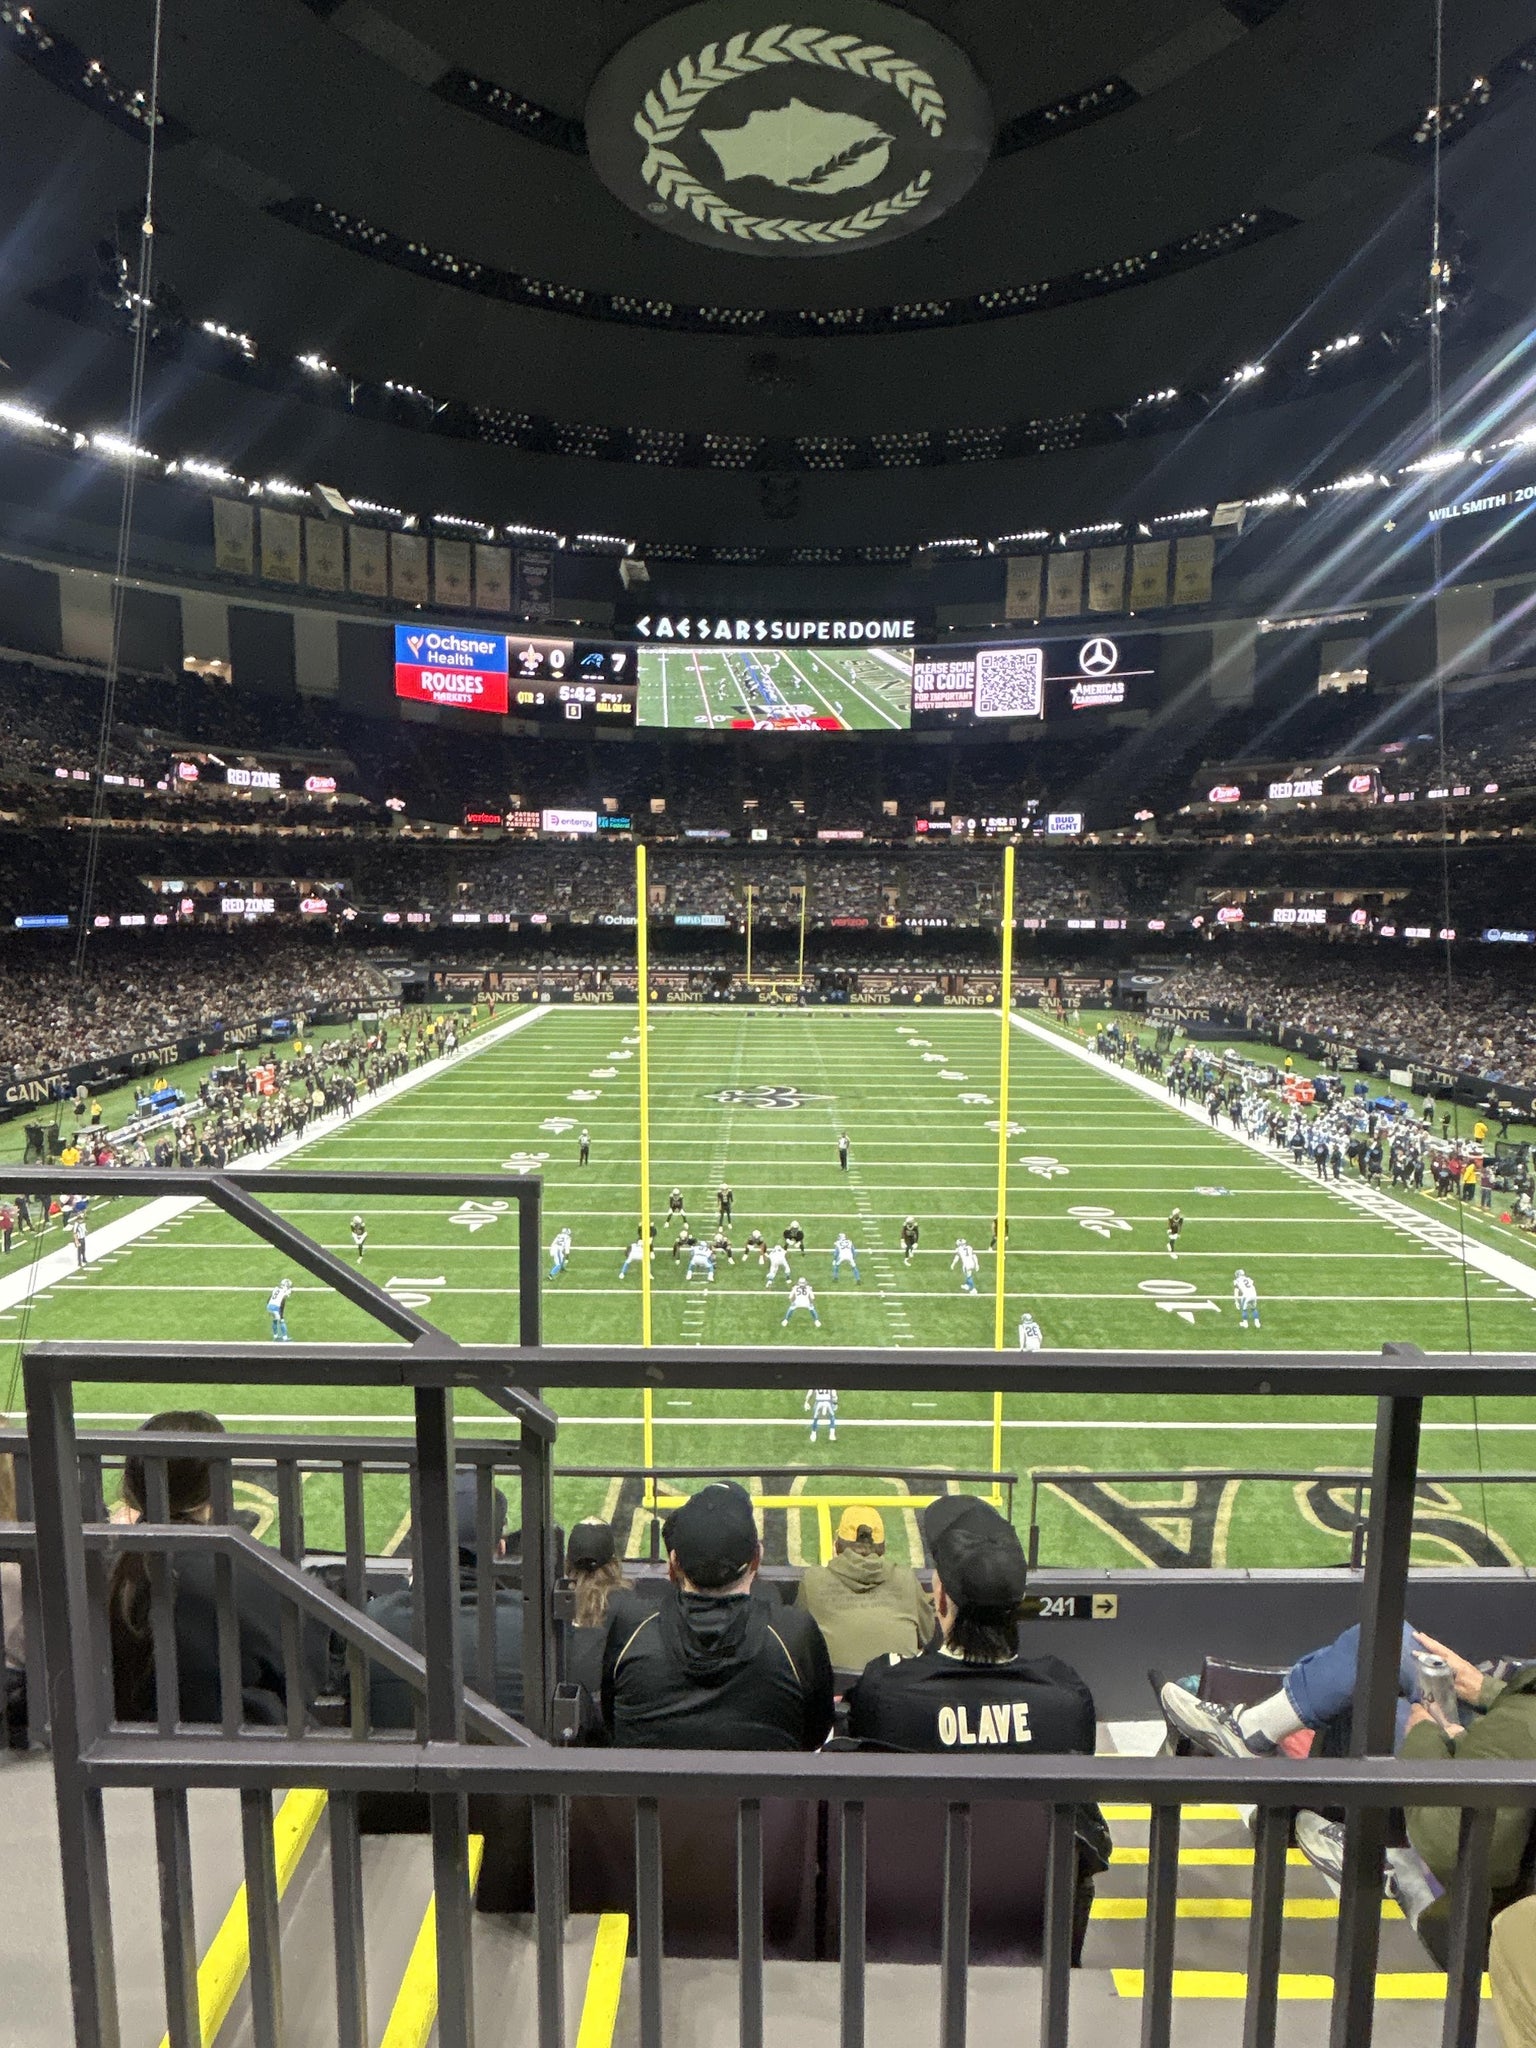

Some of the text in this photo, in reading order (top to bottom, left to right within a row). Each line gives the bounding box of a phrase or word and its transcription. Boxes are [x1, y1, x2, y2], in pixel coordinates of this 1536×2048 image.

[1429, 486, 1536, 521] WILL SMITH 20
[636, 616, 915, 641] CAESARS SUPERDOME
[425, 633, 496, 654] Ochsner
[428, 651, 473, 667] Health
[550, 649, 565, 668] 0
[611, 653, 627, 672] 7
[915, 662, 975, 674] PLEASE SCAN
[421, 671, 484, 694] ROUSES
[914, 673, 974, 692] QR CODE
[1076, 682, 1124, 695] AMERICAS
[433, 691, 472, 704] MARKETS
[517, 691, 545, 705] QTR 2
[559, 685, 596, 703] 5:42
[915, 691, 973, 701] FOR IMPORTANT
[227, 768, 280, 788] RED ZONE
[1269, 780, 1323, 798] RED ZONE
[467, 813, 500, 823] verizon
[561, 819, 593, 828] entergy
[1051, 823, 1077, 831] LIGHT
[222, 899, 275, 912] RED ZONE
[604, 915, 645, 925] Ochsn
[831, 918, 869, 927] verizon
[1273, 909, 1326, 923] RED ZONE
[477, 992, 519, 1002] SAINTS
[573, 992, 615, 1002] SAINTS
[850, 993, 891, 1003] SAINTS
[943, 995, 985, 1005] SAINTS
[6, 1074, 66, 1102] SAINT
[1067, 1206, 1133, 1231] 20
[1039, 1597, 1075, 1616] 241
[938, 1703, 1032, 1745] OLAVE
